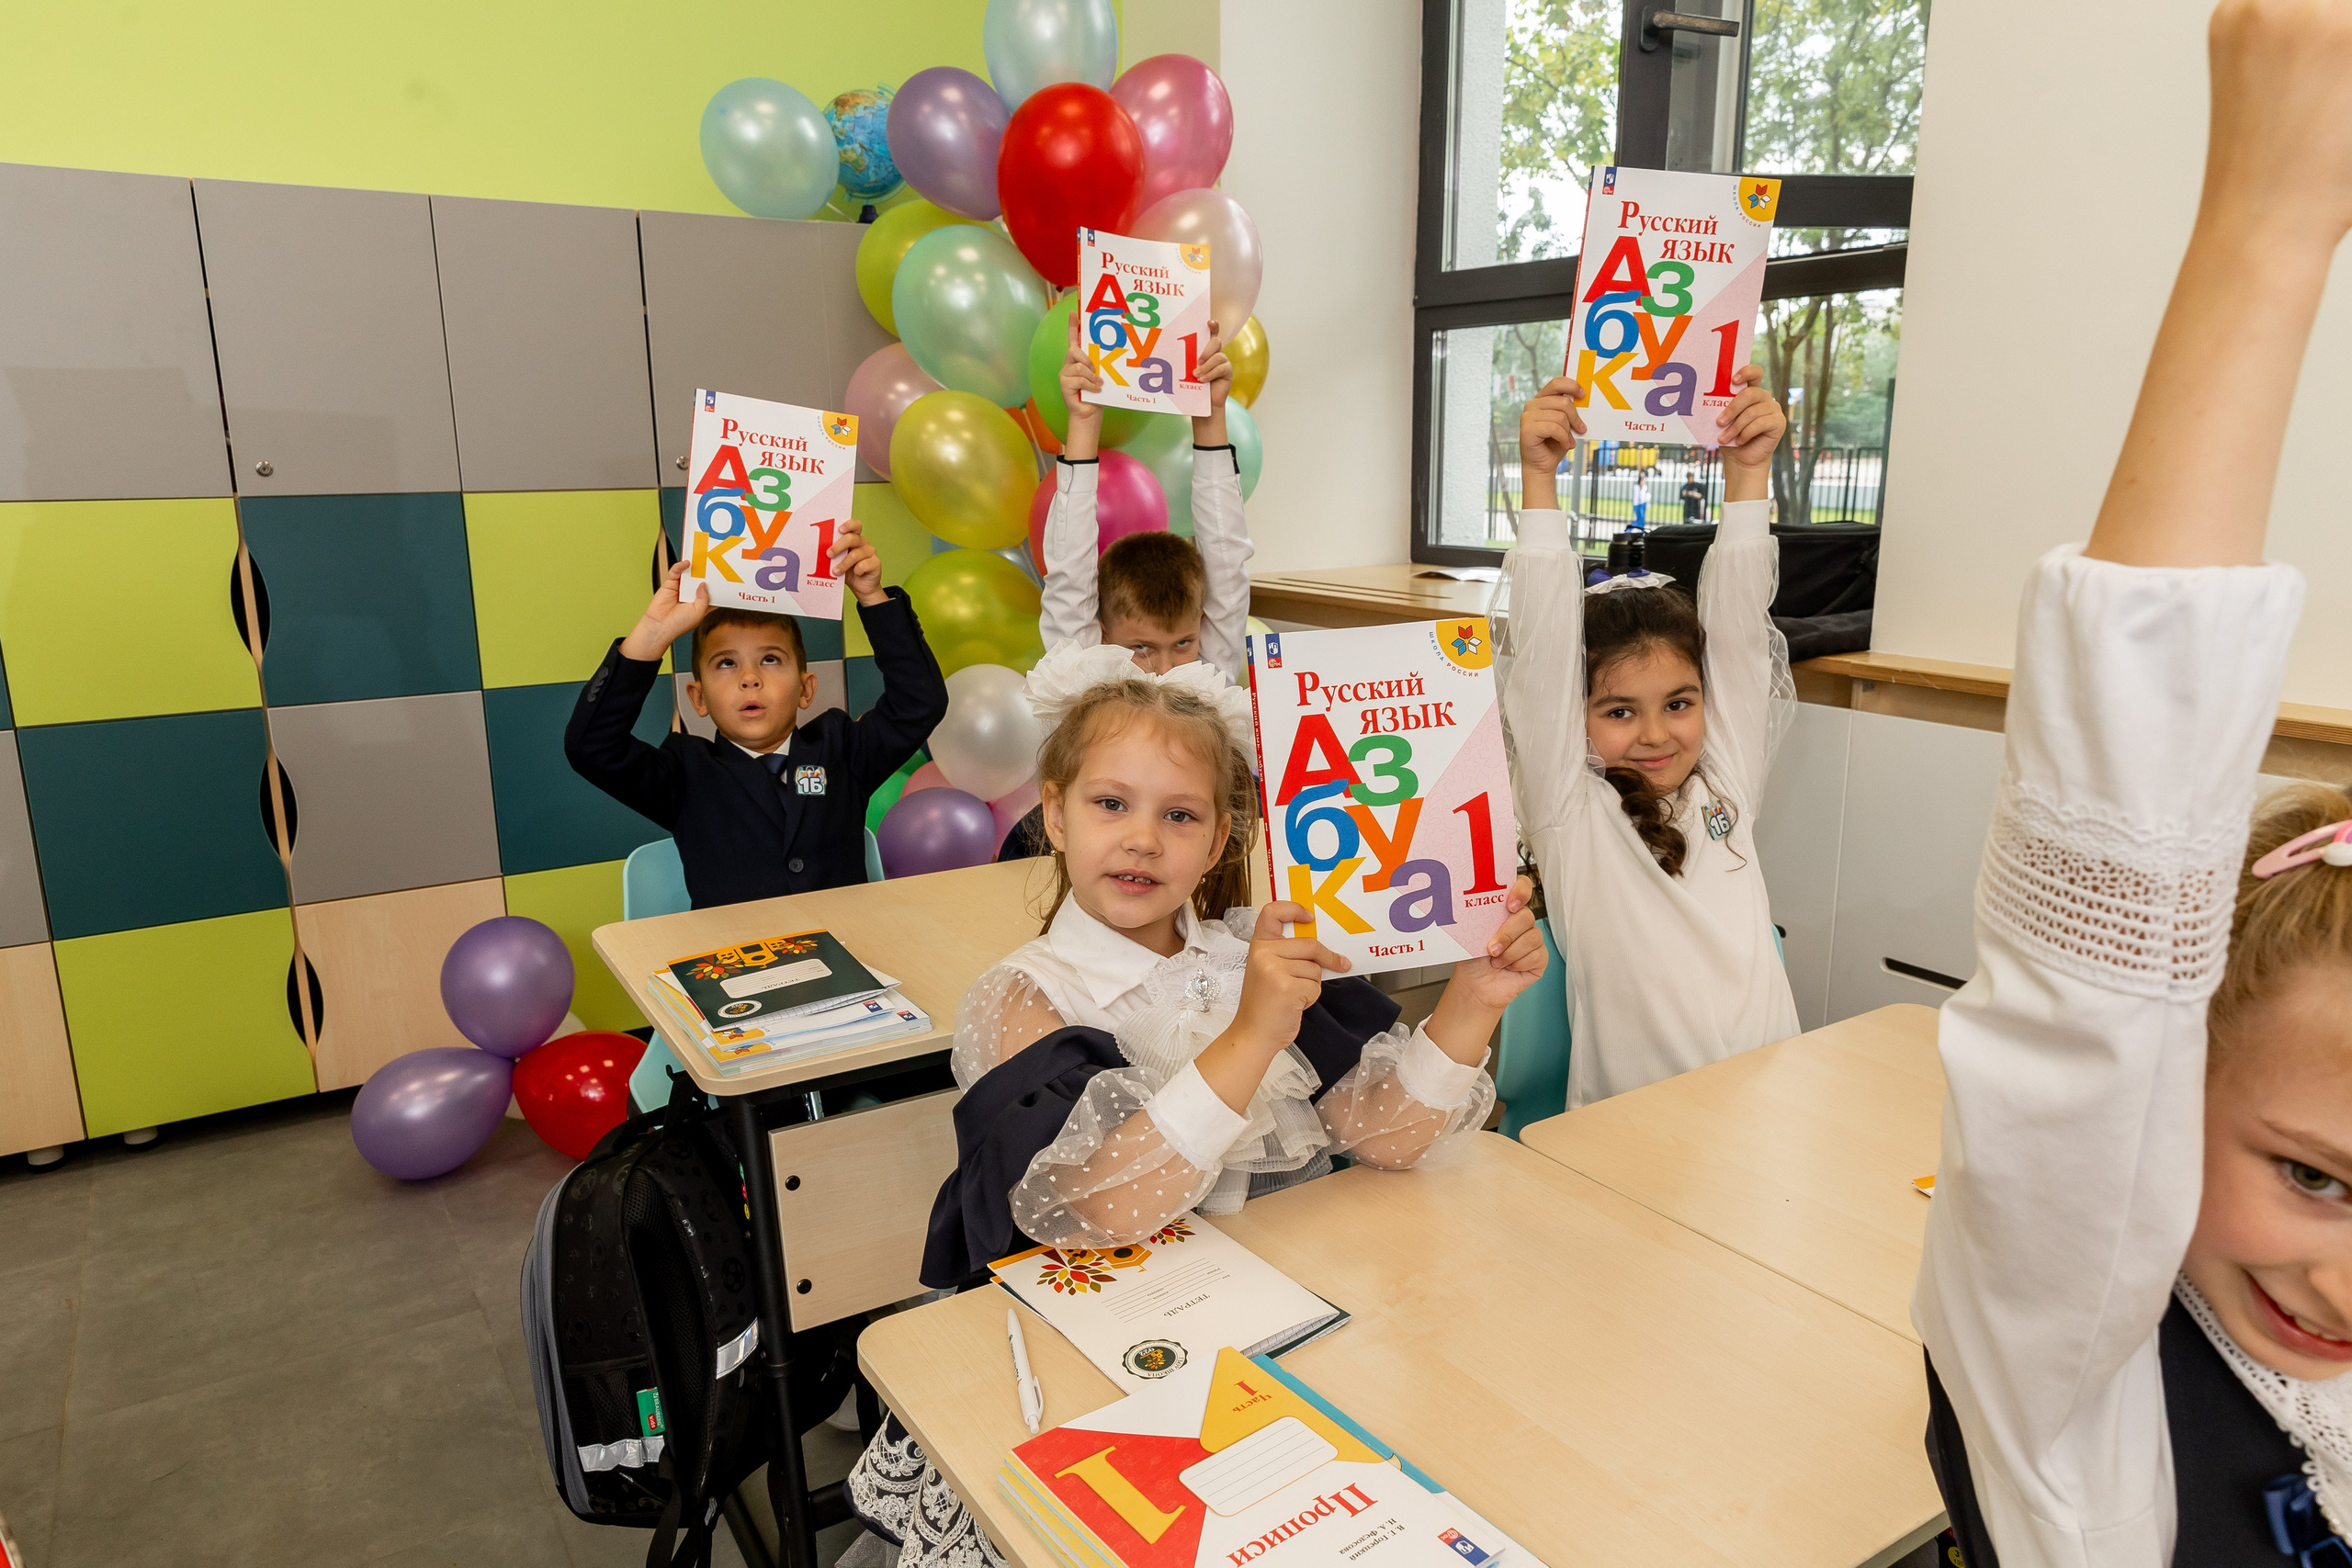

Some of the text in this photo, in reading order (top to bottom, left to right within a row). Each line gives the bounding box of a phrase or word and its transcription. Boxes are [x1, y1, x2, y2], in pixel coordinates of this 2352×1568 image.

[1617, 200, 1718, 236] Русский
[1101, 251, 1170, 279] Русский
[1177, 332, 1204, 384] 1
[1703, 320, 1740, 398] 1
[1125, 394, 1150, 403] Часть
[720, 418, 808, 452] Русский
[1624, 420, 1666, 432] Часть 1
[807, 518, 838, 581] 1
[806, 579, 835, 589] класс
[738, 592, 769, 604] Часть
[1429, 631, 1479, 677] ШКОЛА РОССИИ
[1294, 671, 1425, 712] Русский
[1452, 791, 1507, 896] 1
[1464, 893, 1504, 908] класс
[1368, 939, 1425, 958] Часть 1
[1163, 1293, 1211, 1317] ТЕТРАДЬ
[1148, 1368, 1174, 1377] ШКОЛА
[1232, 1394, 1272, 1412] Часть
[1226, 1482, 1379, 1568] Прописи
[1339, 1529, 1378, 1555] Федосова
[1349, 1535, 1389, 1562] Горецкий
